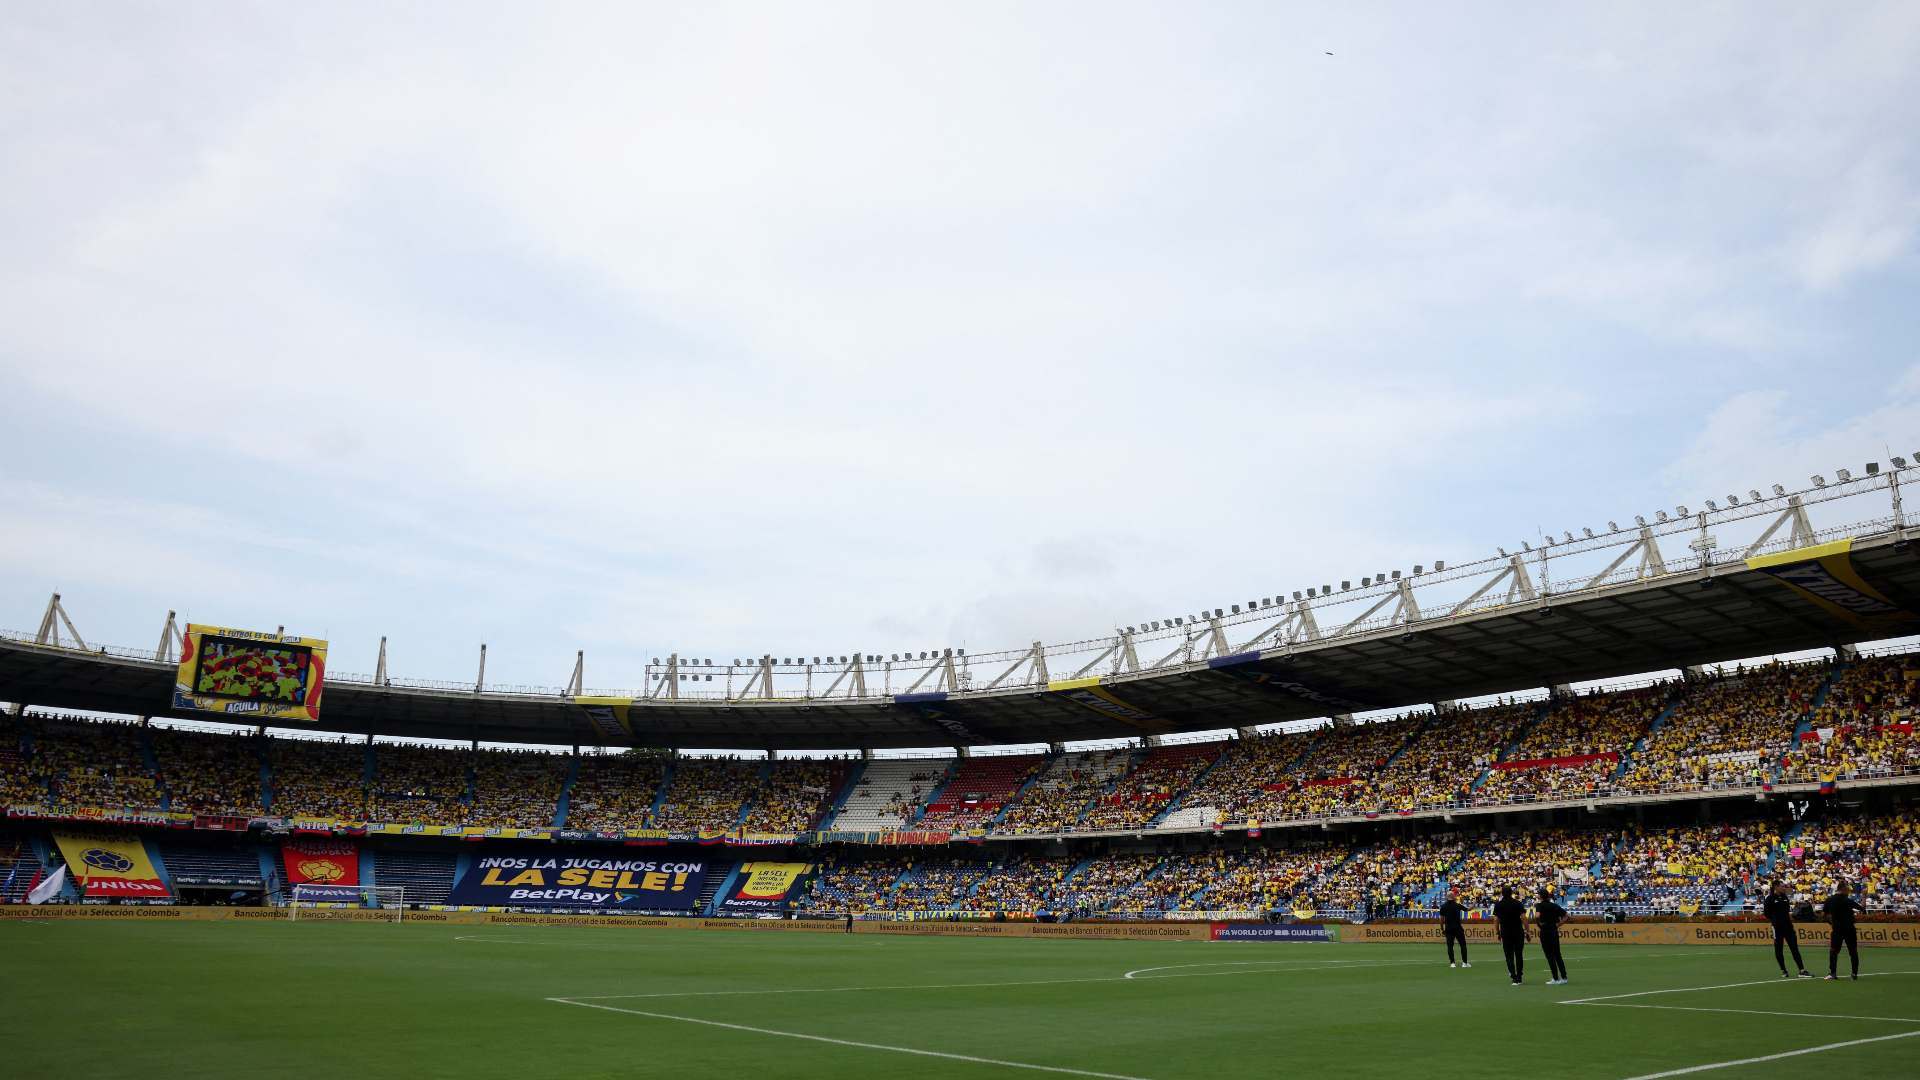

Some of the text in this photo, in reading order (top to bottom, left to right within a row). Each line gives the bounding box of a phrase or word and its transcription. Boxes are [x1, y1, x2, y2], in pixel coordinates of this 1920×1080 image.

[228, 629, 253, 638] FÚTBOL
[227, 702, 259, 713] AGUILA
[299, 820, 329, 831] ÚTICA
[810, 831, 819, 843] EL
[867, 831, 879, 844] NO
[881, 832, 894, 844] ES
[897, 831, 949, 844] VANDALISMO
[286, 839, 356, 850] VIBREMOS
[479, 857, 702, 873] ¡NOS LA JUGAMOS CON
[480, 868, 689, 891] LA SELE!
[510, 889, 611, 904] BetPlay
[725, 899, 770, 907] BetPlay
[0, 907, 180, 918] Banco Oficial de la Selección Colombia
[234, 910, 291, 920] Bancolombia,
[302, 911, 325, 919] Banco
[328, 911, 353, 920] Oficial
[354, 911, 364, 920] de
[365, 911, 373, 920] la
[411, 913, 447, 922] Colombia
[491, 915, 668, 927] Bancolombia, el Banco Oficial de la Selección Colombia
[1033, 926, 1069, 935] Bancolombia,
[1075, 927, 1093, 935] Banco
[1093, 926, 1113, 935] Oficial
[1113, 927, 1121, 936] de
[1122, 928, 1128, 936] la
[1128, 927, 1158, 936] Selección
[1158, 927, 1190, 937] Colombia
[1366, 928, 1424, 939] Bancolombia,
[1425, 928, 1434, 938] el
[1465, 927, 1495, 939] Oficial
[1572, 927, 1624, 939] Colombia
[1891, 929, 1910, 941] de
